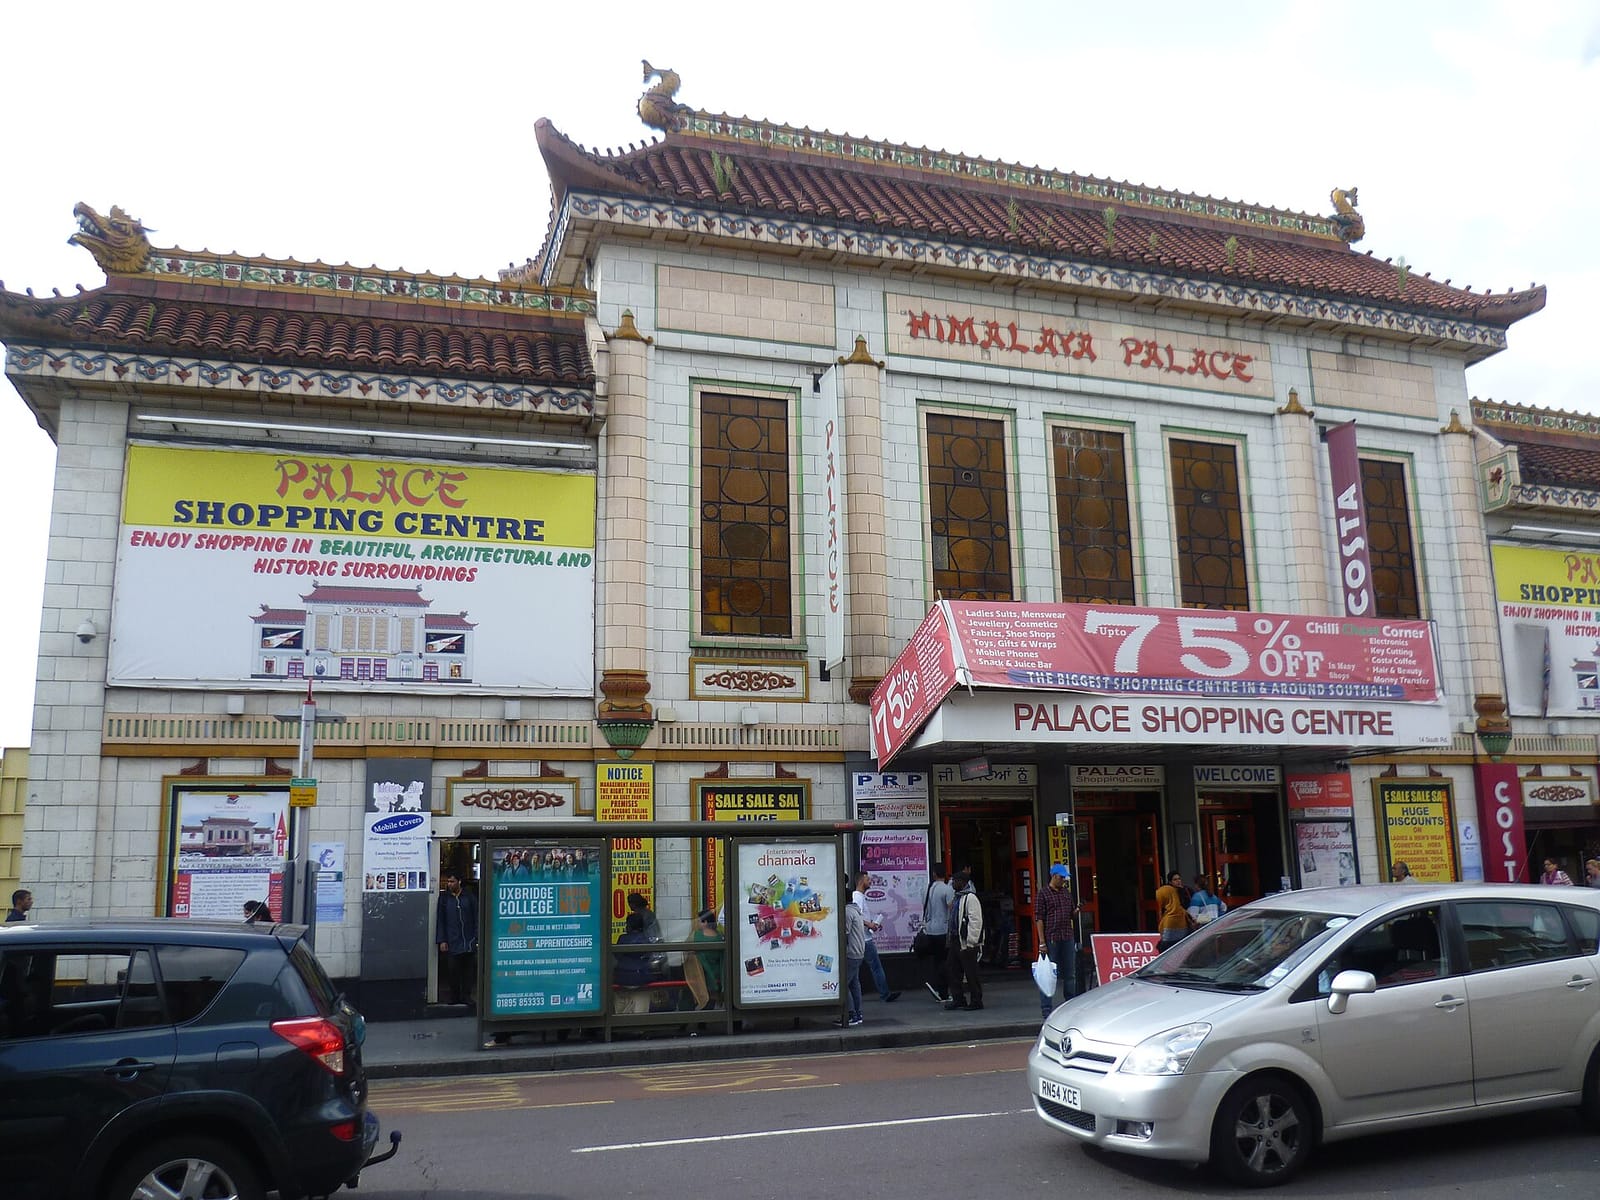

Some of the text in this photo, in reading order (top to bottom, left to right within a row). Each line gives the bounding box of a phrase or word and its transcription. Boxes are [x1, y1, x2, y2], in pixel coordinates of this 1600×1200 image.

[908, 309, 1254, 384] HIMALAYA PALACE
[275, 459, 468, 508] PALACE
[174, 500, 545, 541] SHOPPING CENTRE
[825, 419, 840, 613] PALACE
[131, 531, 591, 568] ENJOY SHOPPING IN BEAUTIFUL, ARCHITECTURAL AND
[1337, 483, 1369, 616] COSTA
[254, 559, 478, 582] HISTORIC SURROUNDINGS
[965, 609, 1066, 619] Ladies Suits, Menswear
[1503, 605, 1532, 618] ENJOY
[1534, 607, 1579, 622] SHOPPING
[1582, 611, 1591, 622] IN
[968, 619, 1058, 629] Jewellery, Cosmetics
[1306, 622, 1340, 635] Chilli
[1382, 625, 1424, 638] Corner
[971, 629, 1056, 640] Fabrics, Shoe Shops
[1100, 627, 1127, 637] Upto
[973, 639, 1057, 650] Toys, Gifts & Wraps
[1369, 637, 1409, 646] Electronics
[976, 648, 1039, 658] Mobile Phones
[1371, 647, 1413, 657] Key Cutting
[979, 658, 1004, 666] Snack
[1014, 660, 1036, 668] Juice
[1038, 661, 1052, 669] Bar
[1259, 650, 1324, 678] OFF
[1371, 657, 1417, 666] Costa Coffee
[1372, 666, 1389, 674] Hair
[1397, 667, 1422, 677] Beauty
[1027, 671, 1393, 697] THE BIGGEST SHOPPING CENTRE IN & AROUND SOUTHALL
[1374, 676, 1429, 685] Money Transfer
[903, 670, 919, 710] OFF
[1014, 703, 1394, 736] PALACE SHOPPING CENTRE
[607, 768, 643, 780] NOTICE
[1077, 767, 1155, 776] PALACE
[1196, 768, 1276, 782] WELCOME
[715, 794, 743, 808] SALE
[746, 794, 774, 808] SALE
[1391, 790, 1410, 802] SALE
[1411, 791, 1430, 802] SALE
[1402, 807, 1429, 816] HUGE
[373, 816, 422, 834] Mobile Covers
[1388, 816, 1444, 826] DISCOUNTS
[758, 855, 816, 867] dhamaka
[617, 873, 648, 885] FOYER
[499, 886, 554, 900] UXBRIDGE
[499, 900, 554, 915] COLLEGE
[498, 938, 593, 949] COURSES APPRENTICESHIPS
[1111, 941, 1154, 954] ROAD
[822, 981, 839, 991] sky
[497, 997, 545, 1008] 01895 853333
[1041, 1080, 1078, 1106] RN54 XCE
